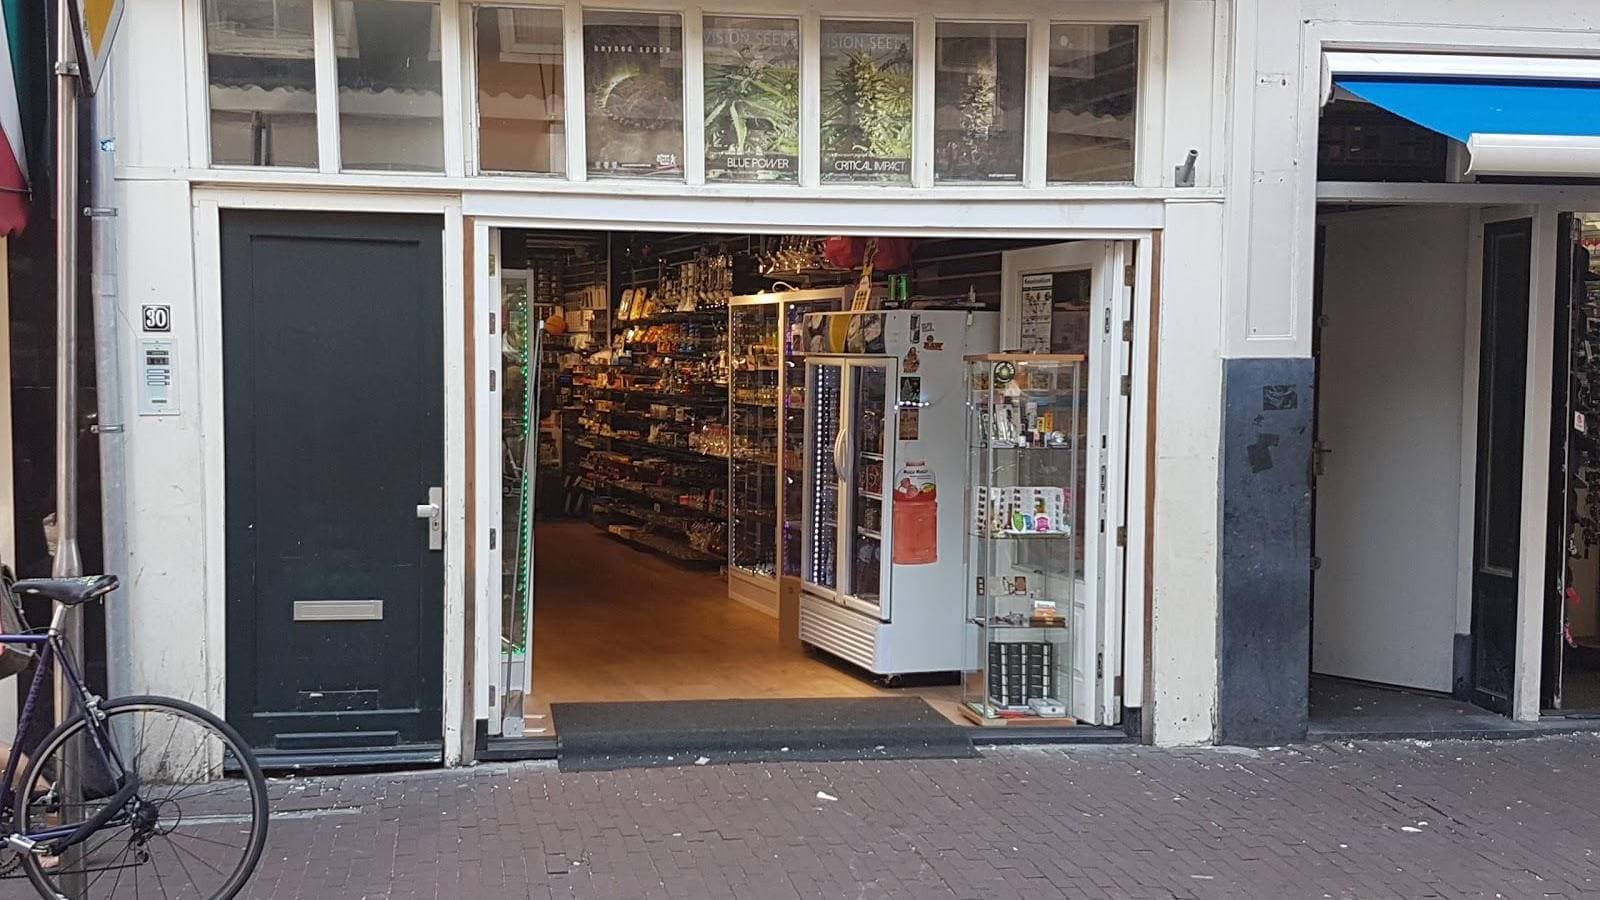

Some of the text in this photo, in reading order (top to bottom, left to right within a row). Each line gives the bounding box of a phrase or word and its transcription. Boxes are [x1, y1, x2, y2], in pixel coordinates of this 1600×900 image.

[727, 157, 789, 169] BLUE POWER
[834, 160, 906, 171] CRITICAL IMPACT
[146, 309, 166, 327] 30
